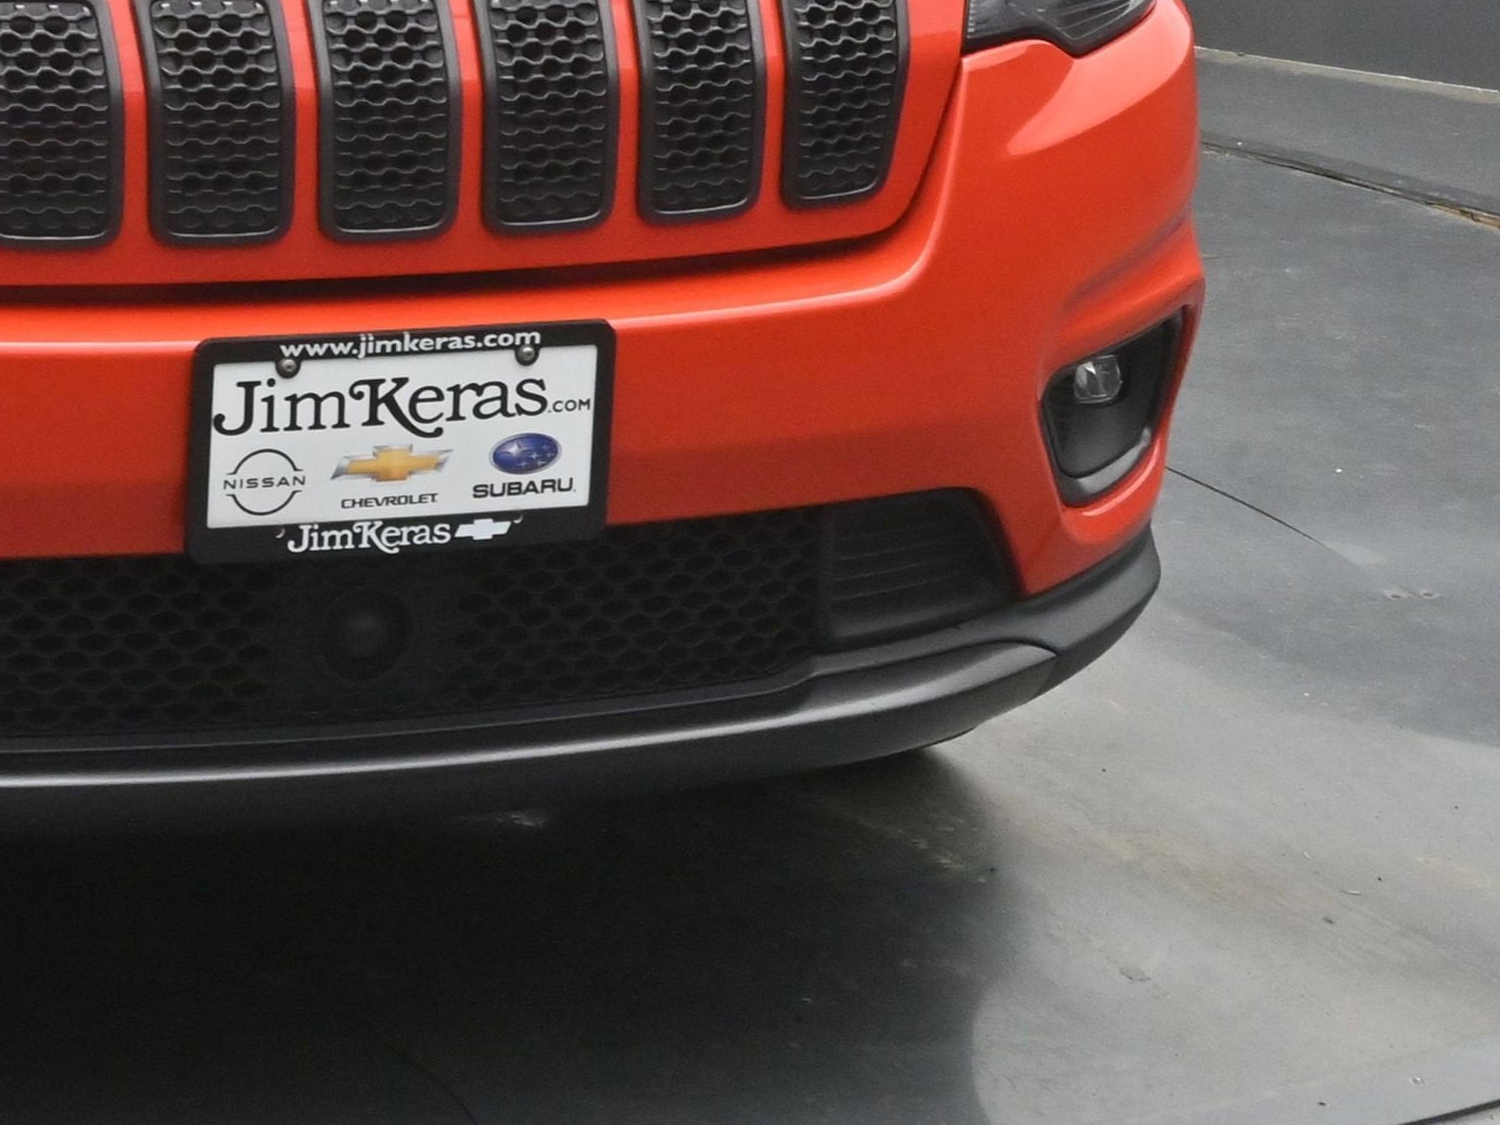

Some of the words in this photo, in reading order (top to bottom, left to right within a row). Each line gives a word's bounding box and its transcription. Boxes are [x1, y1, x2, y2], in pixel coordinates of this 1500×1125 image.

[280, 332, 542, 359] www.jimkeras.com
[223, 475, 306, 491] NISSAN
[472, 477, 574, 499] SUBARU
[341, 493, 438, 509] CHEVROLET
